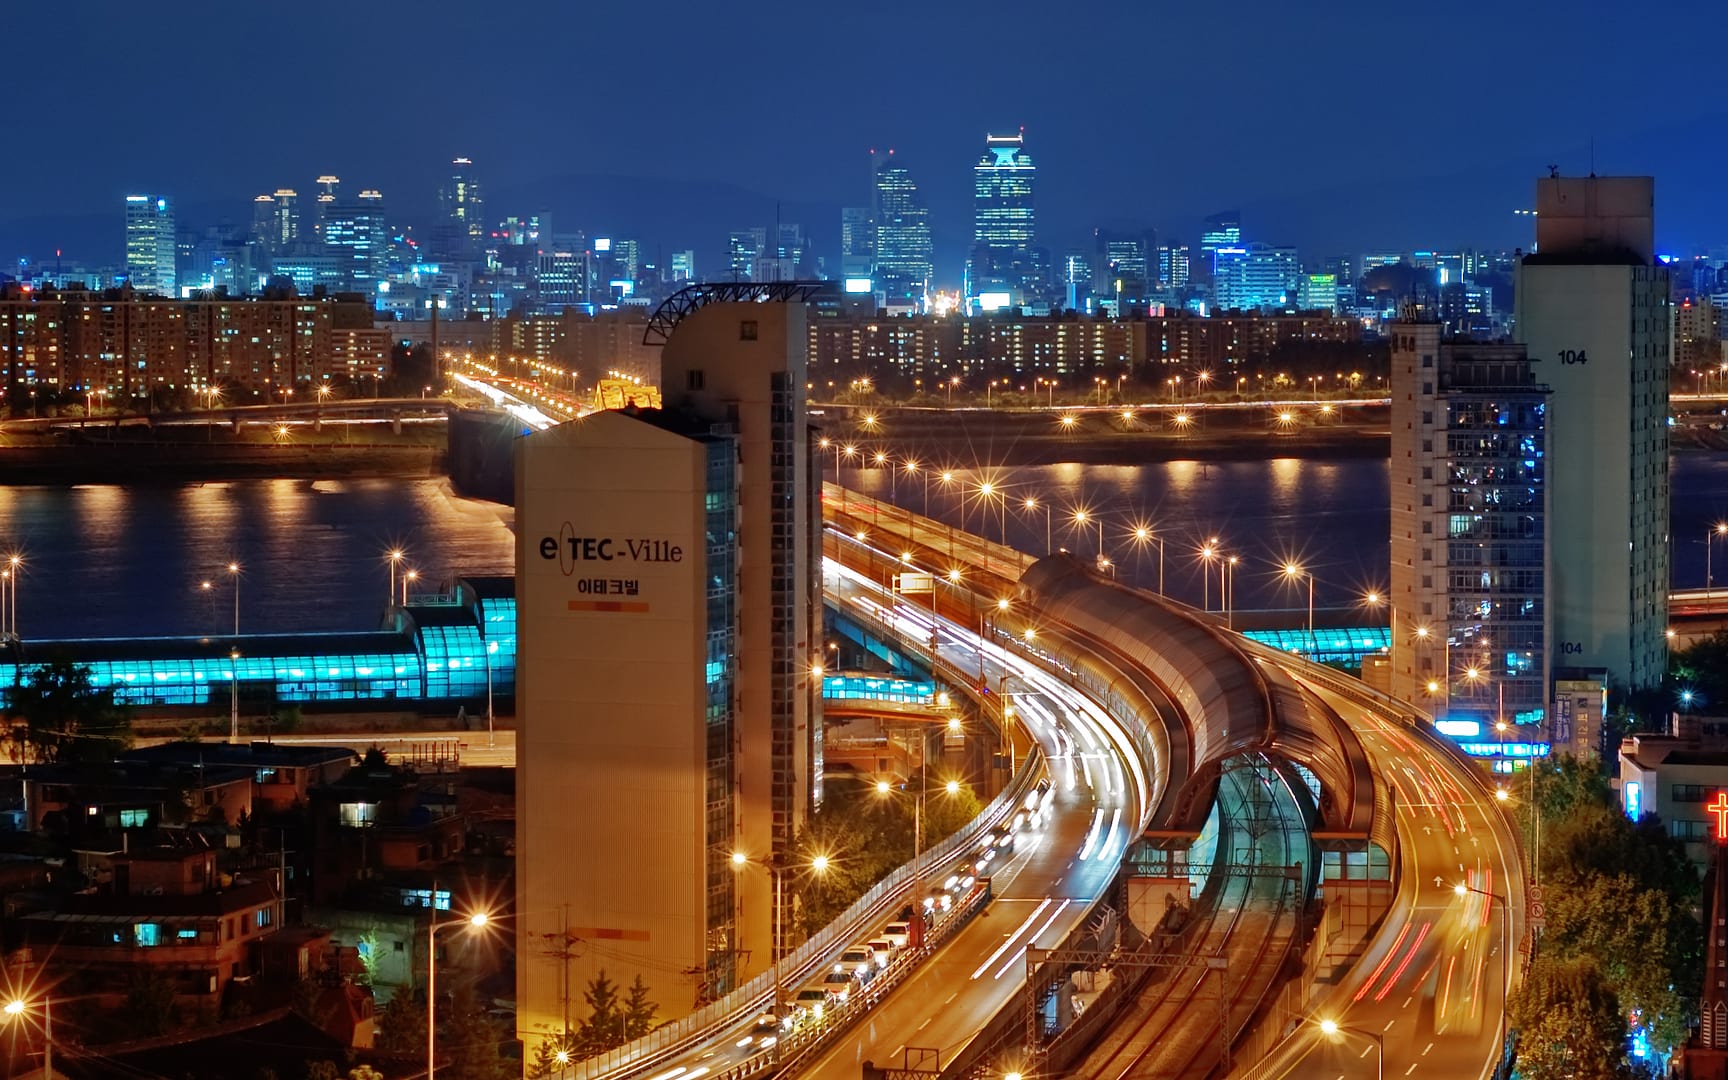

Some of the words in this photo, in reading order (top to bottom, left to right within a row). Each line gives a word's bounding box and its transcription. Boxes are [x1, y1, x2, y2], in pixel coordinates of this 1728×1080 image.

[1558, 349, 1587, 365] 104
[577, 579, 639, 595] 이테크빌
[1560, 642, 1583, 654] 104
